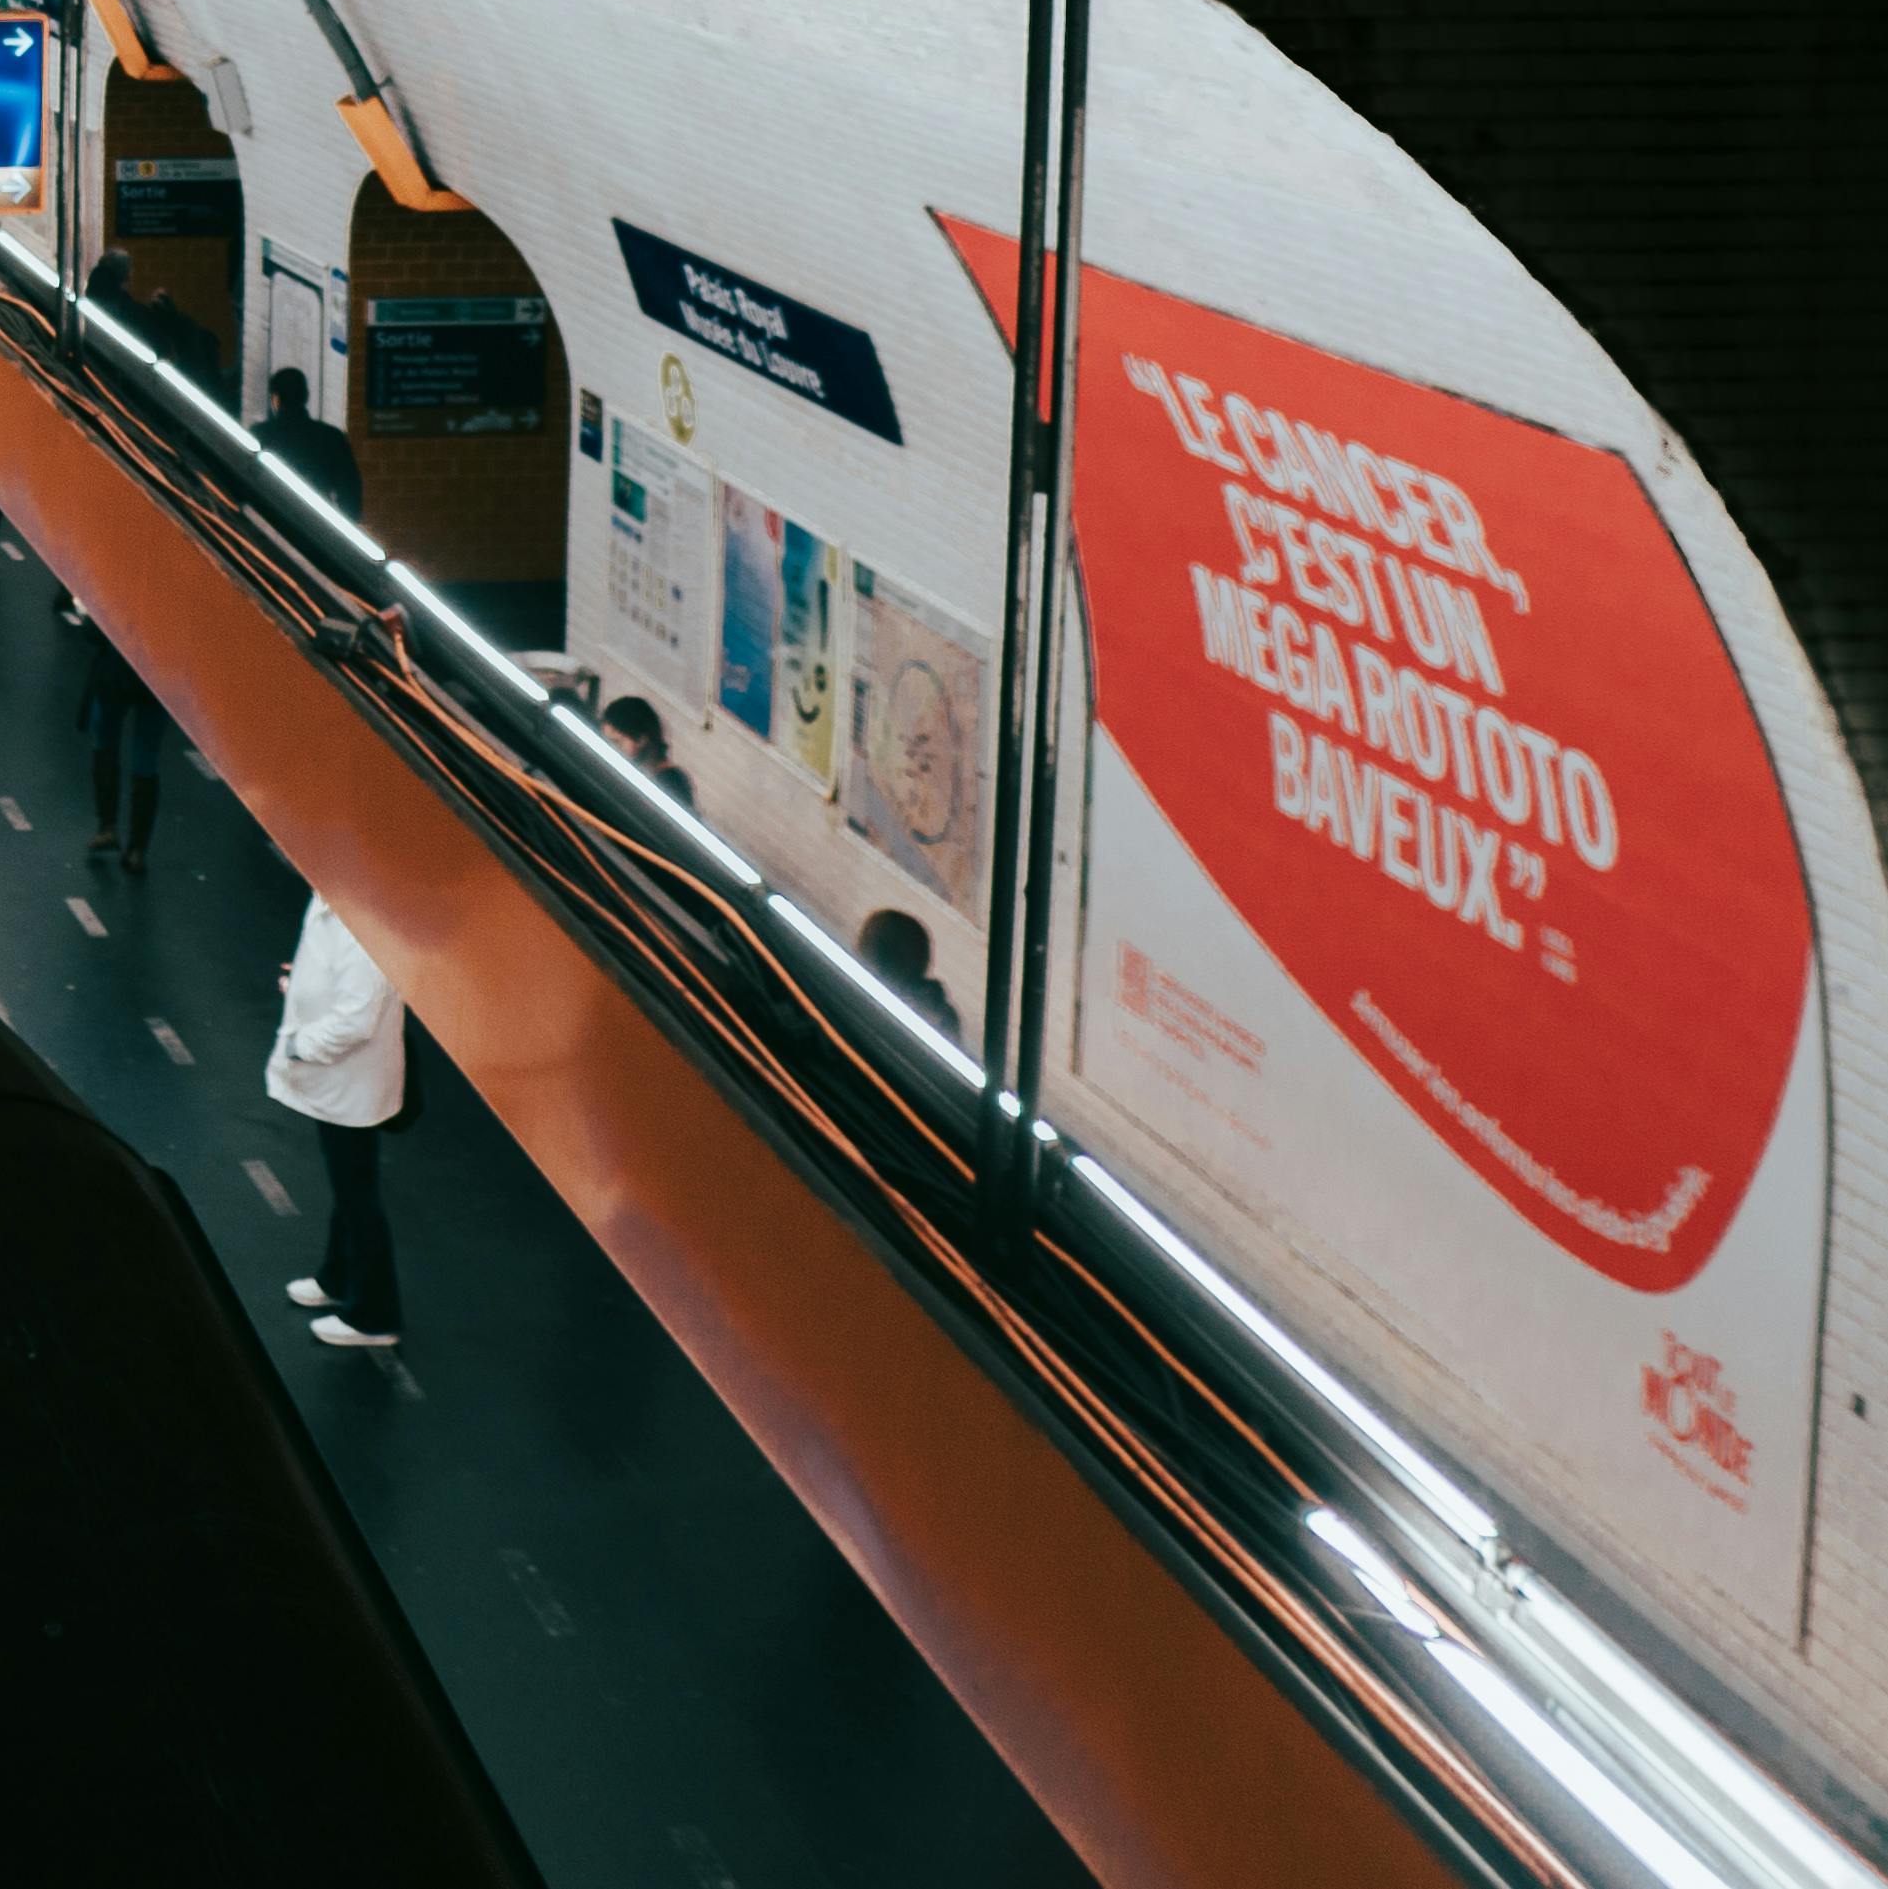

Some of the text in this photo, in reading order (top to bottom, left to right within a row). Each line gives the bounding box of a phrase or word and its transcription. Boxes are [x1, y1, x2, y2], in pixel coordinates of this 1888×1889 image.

[683, 263, 789, 340] Palais Royal
[1223, 392, 1530, 615] CANCER,
[1383, 553, 1506, 697] UN
[1352, 642, 1619, 872] ROTOTO
